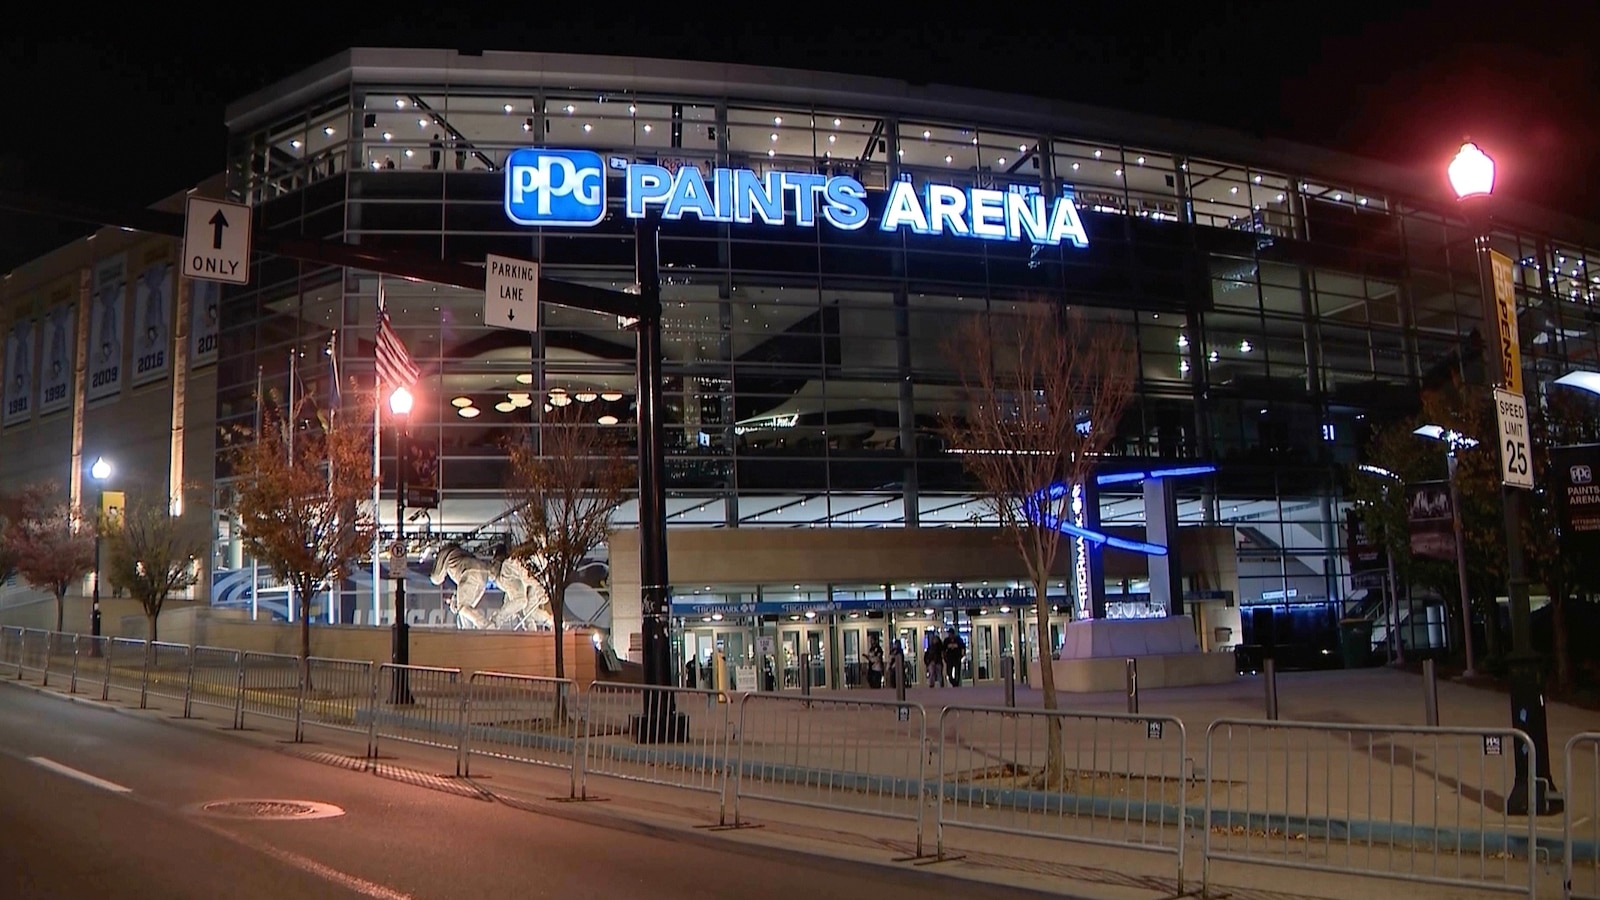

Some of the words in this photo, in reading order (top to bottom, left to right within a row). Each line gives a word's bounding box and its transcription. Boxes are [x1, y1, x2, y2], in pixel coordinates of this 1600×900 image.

[512, 155, 600, 215] PPG
[625, 164, 870, 230] PAINTS
[879, 180, 1090, 248] ARENA
[192, 256, 239, 275] ONLY
[492, 262, 533, 281] PARKING
[500, 284, 524, 302] LANE
[137, 351, 164, 373] 2016
[92, 366, 118, 388] 2009
[44, 383, 66, 403] 1992
[8, 397, 28, 414] 1991
[1500, 401, 1524, 419] SPEED
[1504, 421, 1523, 437] LIMIT
[1506, 439, 1527, 475] 25
[1567, 485, 1600, 496] PAINTS
[1569, 494, 1600, 505] ARENA
[1074, 512, 1089, 610] HIGHMAK
[692, 604, 739, 614] HIGHMARK
[781, 602, 828, 612] HIGHMARK
